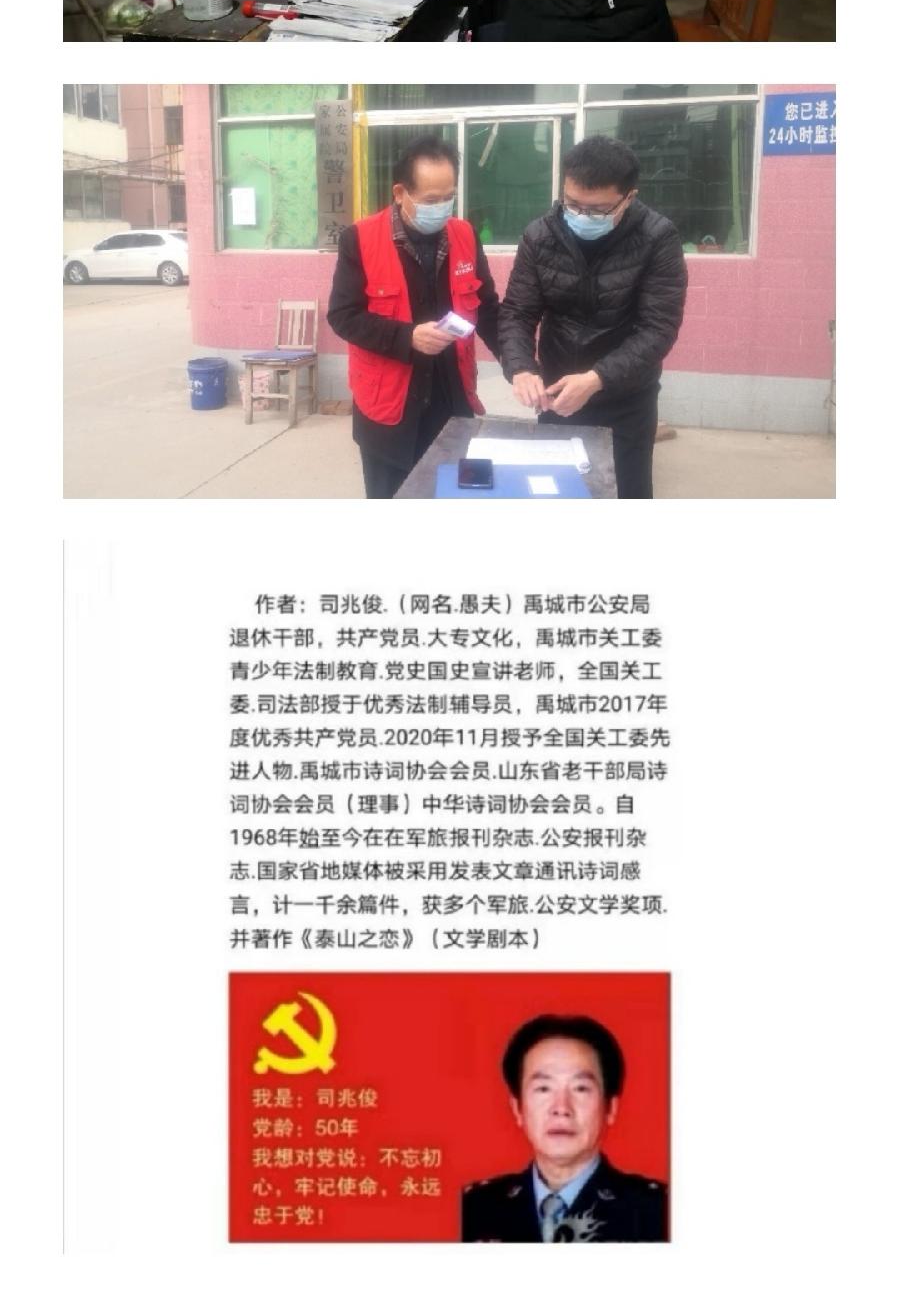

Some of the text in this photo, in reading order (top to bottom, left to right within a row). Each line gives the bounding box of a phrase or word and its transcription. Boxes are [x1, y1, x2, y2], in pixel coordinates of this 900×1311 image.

[335, 104, 348, 156] 公安局
[252, 1088, 378, 1108] 我是：司兆俊
[252, 1118, 359, 1137] 党龄：50年
[252, 1147, 441, 1167] 我想对党说：不忘初
[252, 1176, 441, 1197] 心，牢记使命，永远
